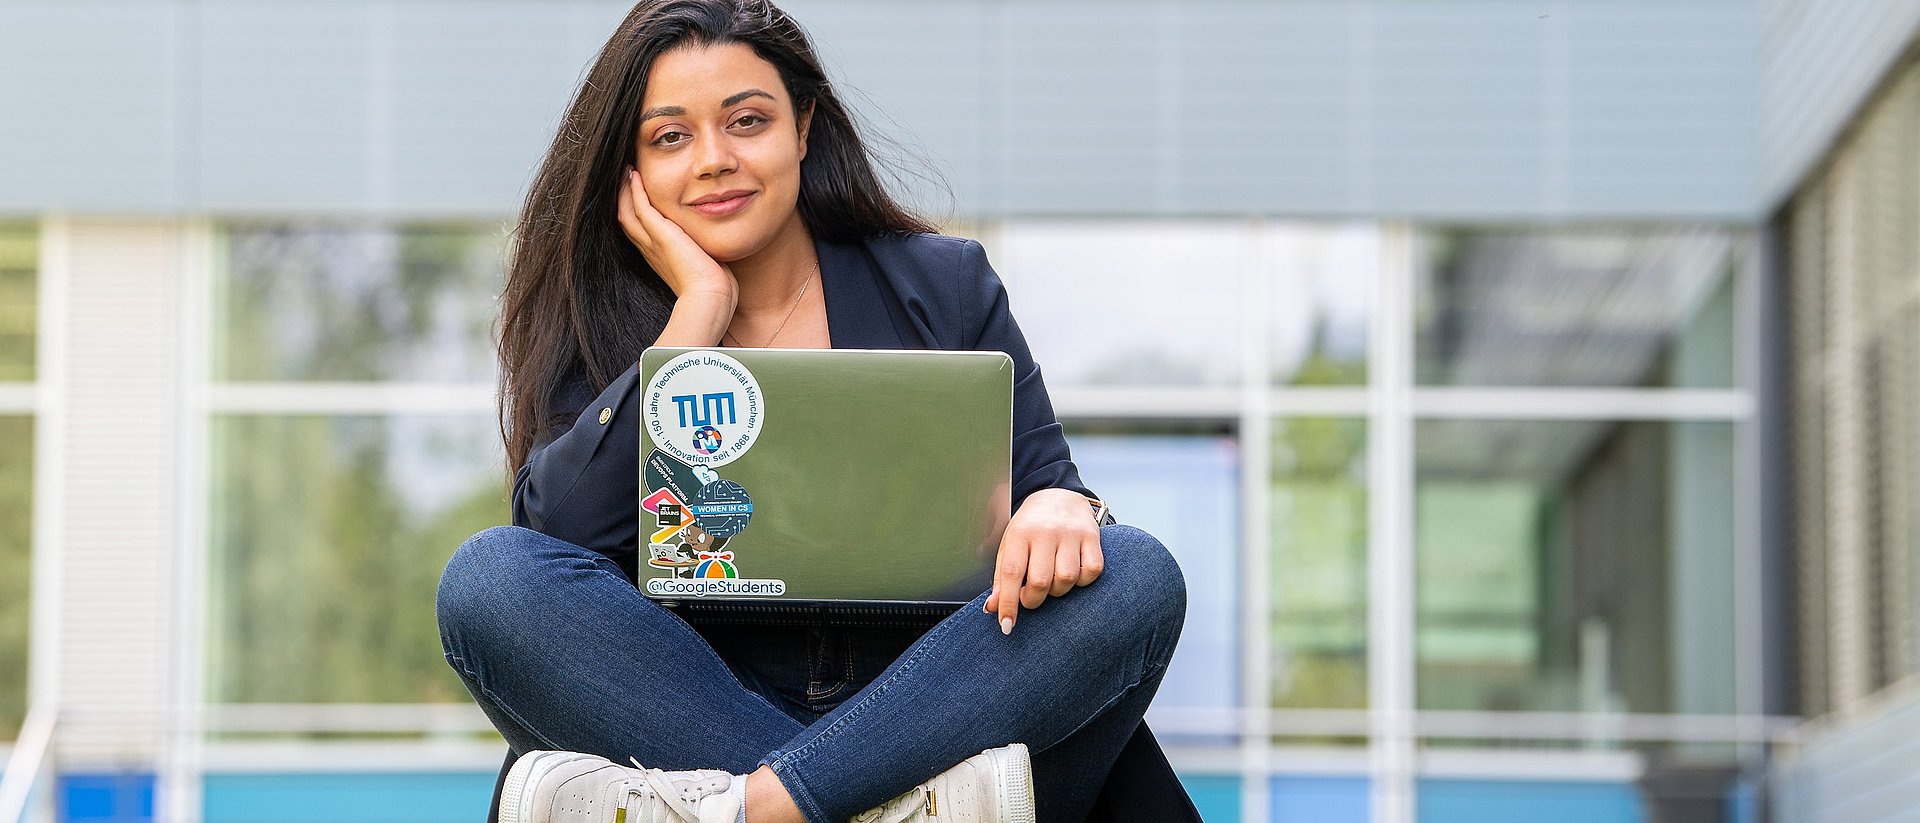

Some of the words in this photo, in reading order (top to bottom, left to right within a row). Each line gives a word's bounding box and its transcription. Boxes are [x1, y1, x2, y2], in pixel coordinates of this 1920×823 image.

[655, 359, 700, 390] Technische
[703, 356, 749, 386] Universität
[650, 392, 660, 418] Jahre
[672, 392, 736, 428] TUM
[745, 386, 758, 429] München
[651, 420, 664, 437] 150
[663, 439, 710, 463] Innovation
[713, 450, 730, 462] seit
[650, 459, 667, 479] DEVOPS
[666, 477, 688, 503] PLATFORM
[698, 505, 727, 513] WOMEN
[648, 580, 783, 595] @GoogleStudents
